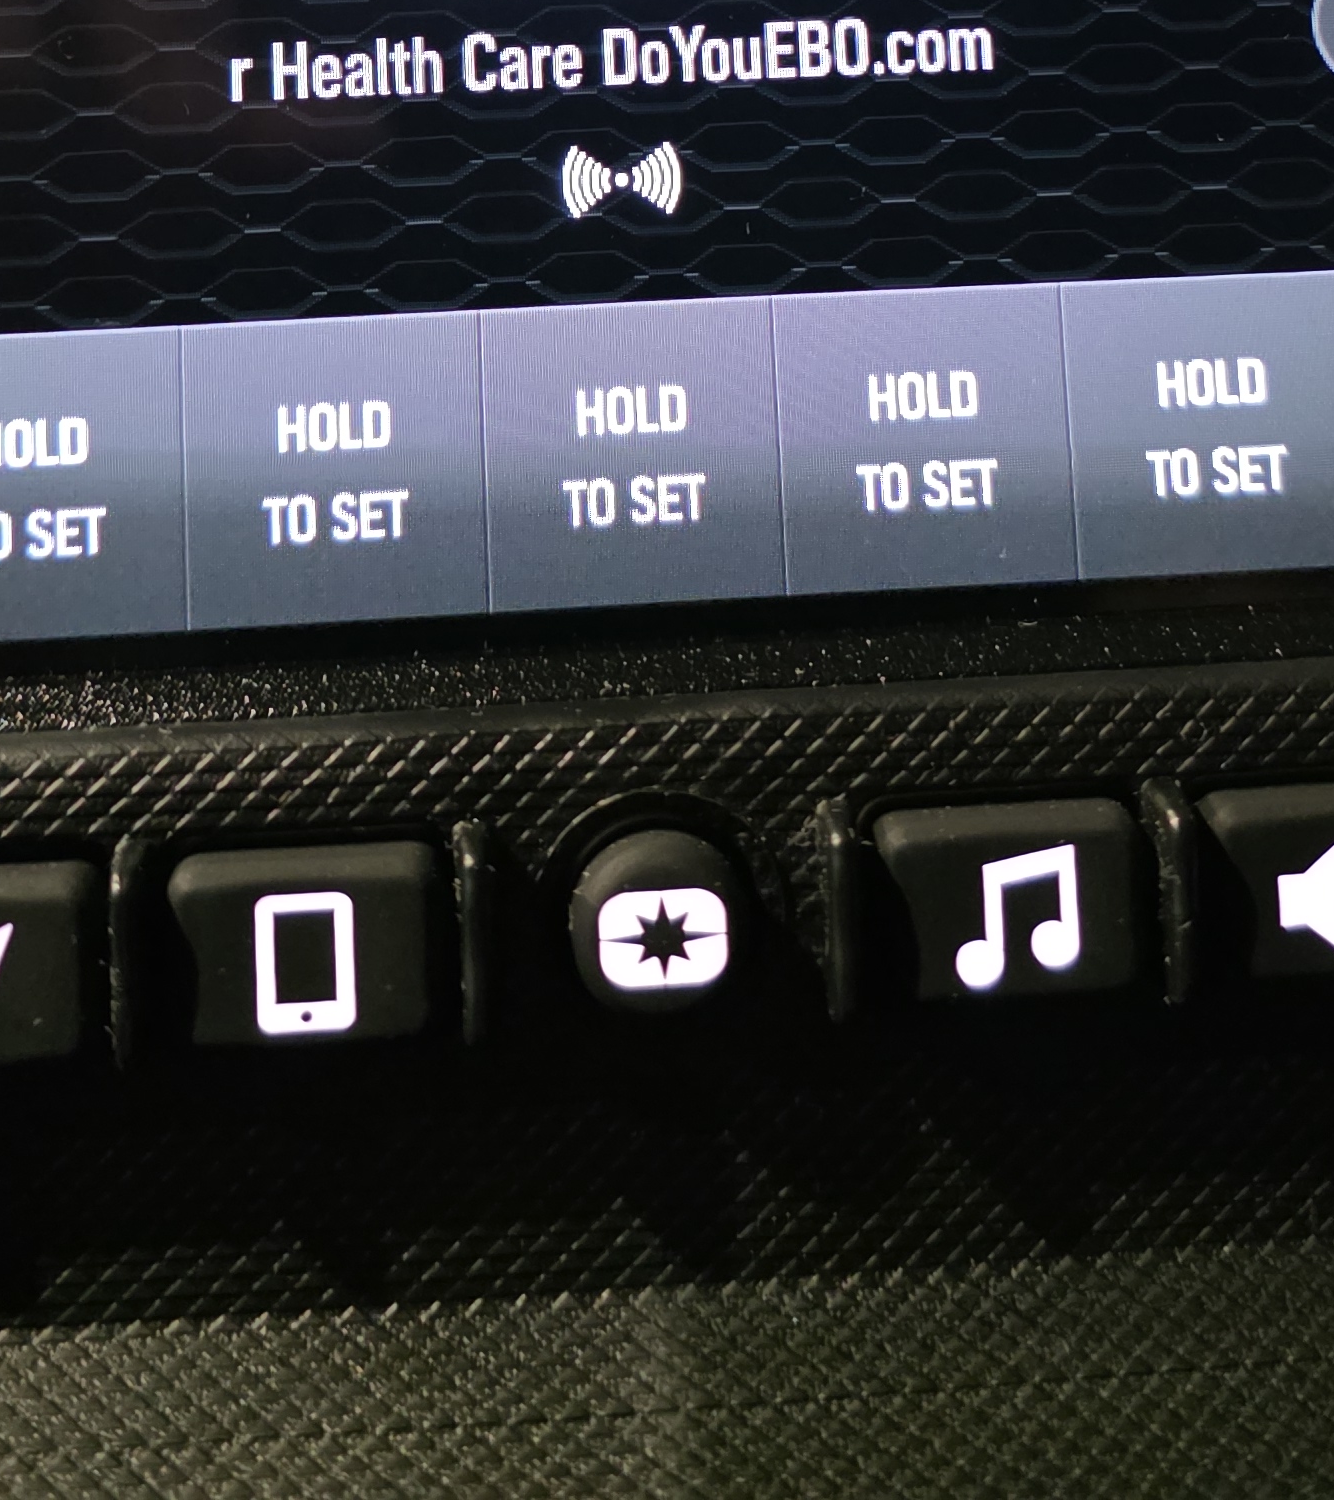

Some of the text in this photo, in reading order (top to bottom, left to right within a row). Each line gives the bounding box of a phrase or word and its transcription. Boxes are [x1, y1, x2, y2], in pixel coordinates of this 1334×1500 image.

[230, 16, 995, 104] r Health Care DoYouEBO.com
[572, 380, 688, 439] HOLD
[867, 368, 979, 423] HOLD
[1155, 356, 1269, 409] HOLD
[276, 398, 393, 455] HOLD
[854, 456, 1000, 512] TO SET
[1144, 442, 1289, 498] TO SET
[261, 488, 410, 546] TO SET
[561, 471, 707, 528] TO SET
[26, 505, 108, 560] SET
